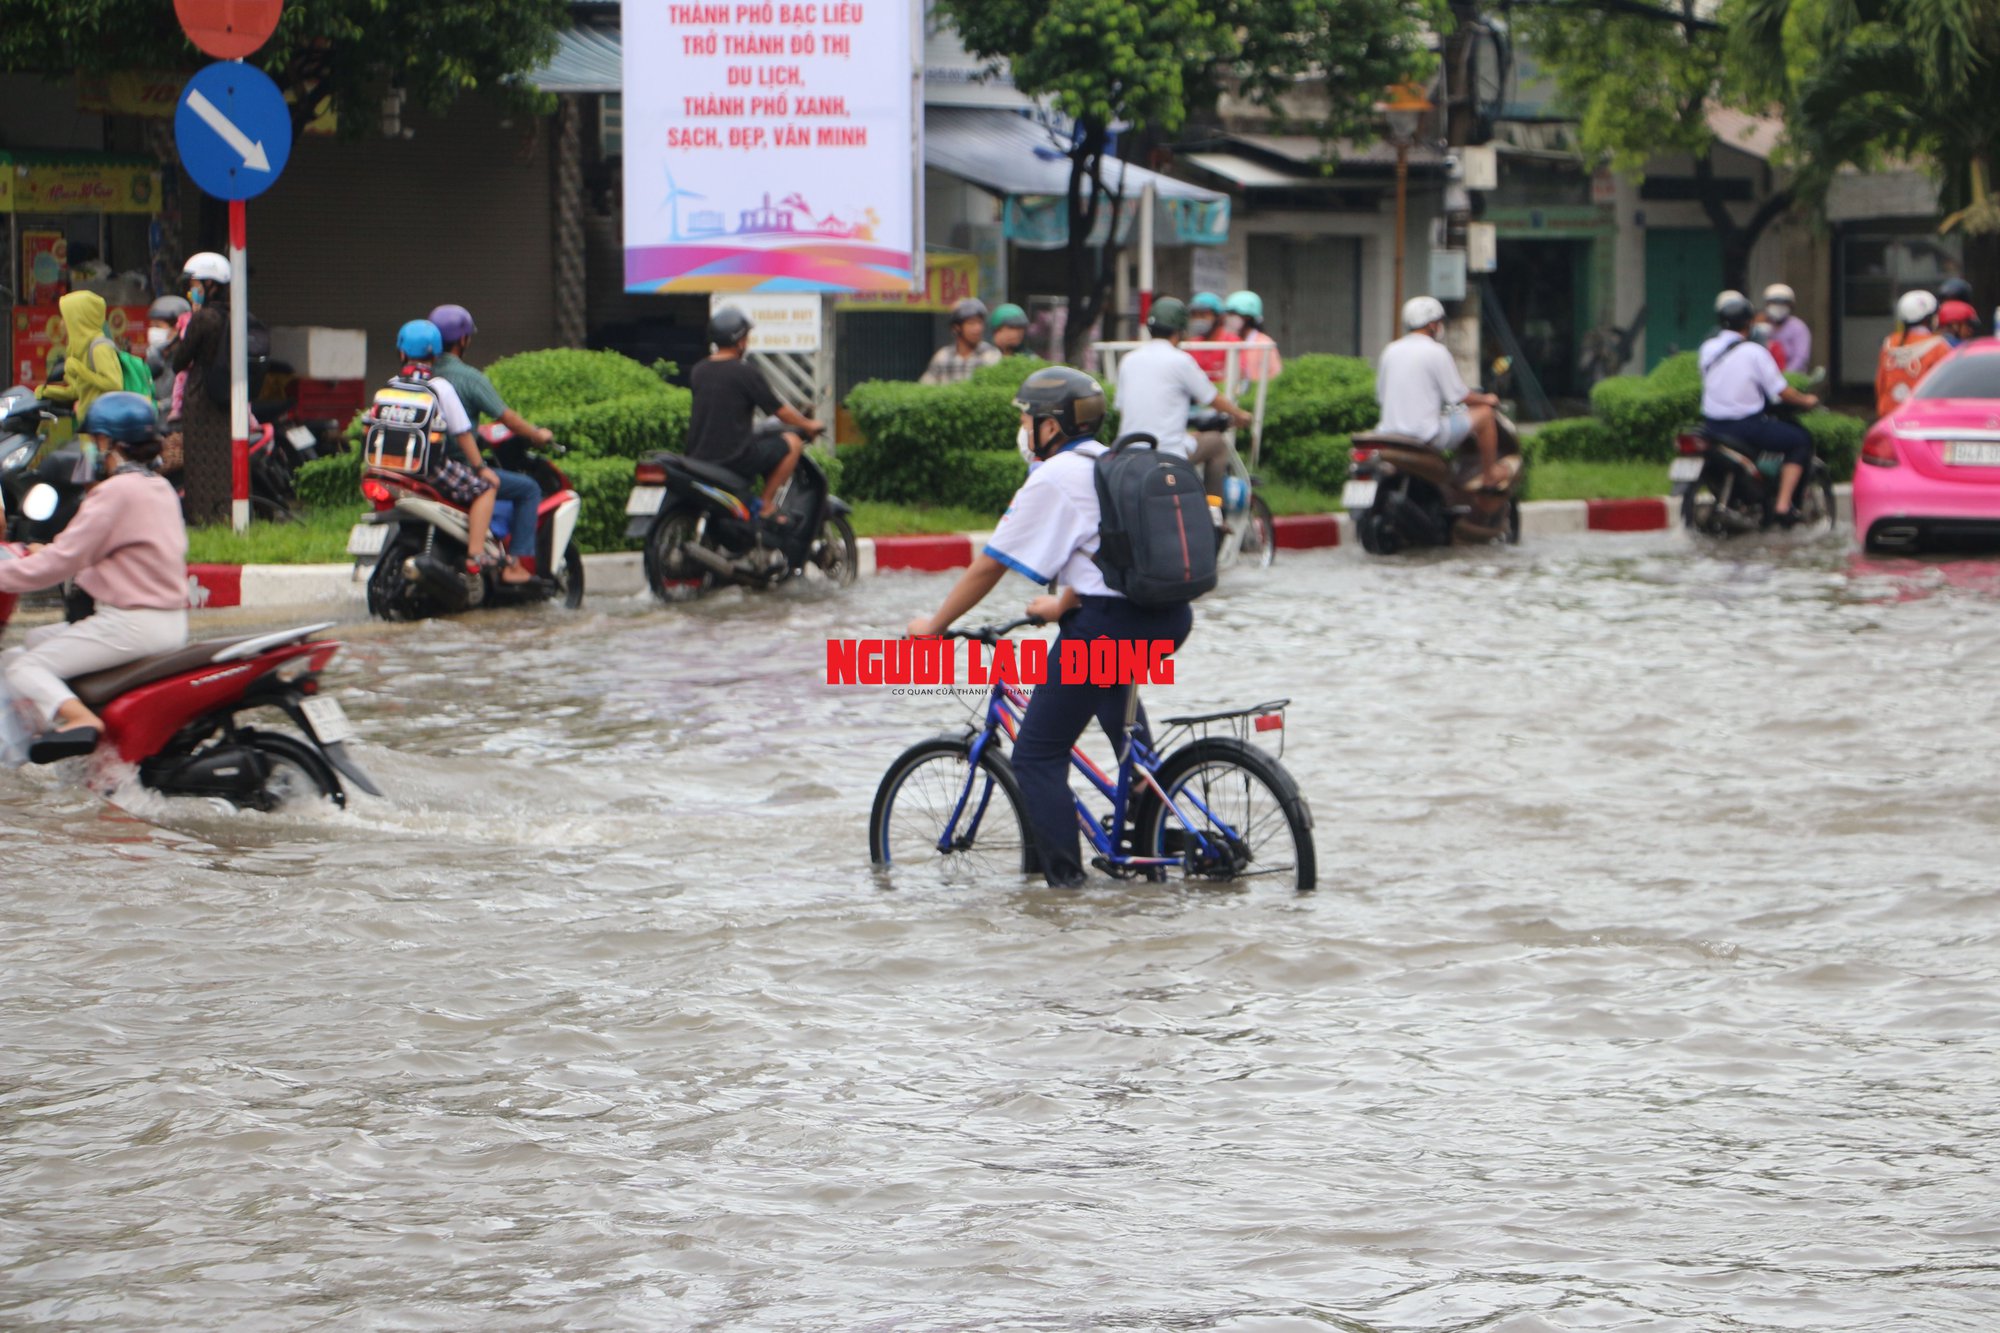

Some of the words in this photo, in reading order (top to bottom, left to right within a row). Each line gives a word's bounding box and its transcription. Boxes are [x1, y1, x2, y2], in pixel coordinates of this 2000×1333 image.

[669, 0, 730, 24] THÀNH
[779, 4, 816, 29] BẠC
[822, 0, 864, 24] LIÊU
[683, 28, 716, 56] TRỞ
[724, 31, 784, 55] THÀNH
[789, 31, 815, 55] ĐÔ
[822, 35, 850, 60] THỊ
[727, 66, 752, 85] DU
[759, 66, 806, 90] LỊCH,
[684, 91, 744, 115] THÀNH
[751, 88, 788, 115] PHỐ
[795, 97, 851, 118] XANH,
[668, 127, 723, 152] SẠCH,
[728, 127, 767, 152] ĐẸP,
[774, 122, 810, 146] VĂN
[816, 127, 867, 146] MINH
